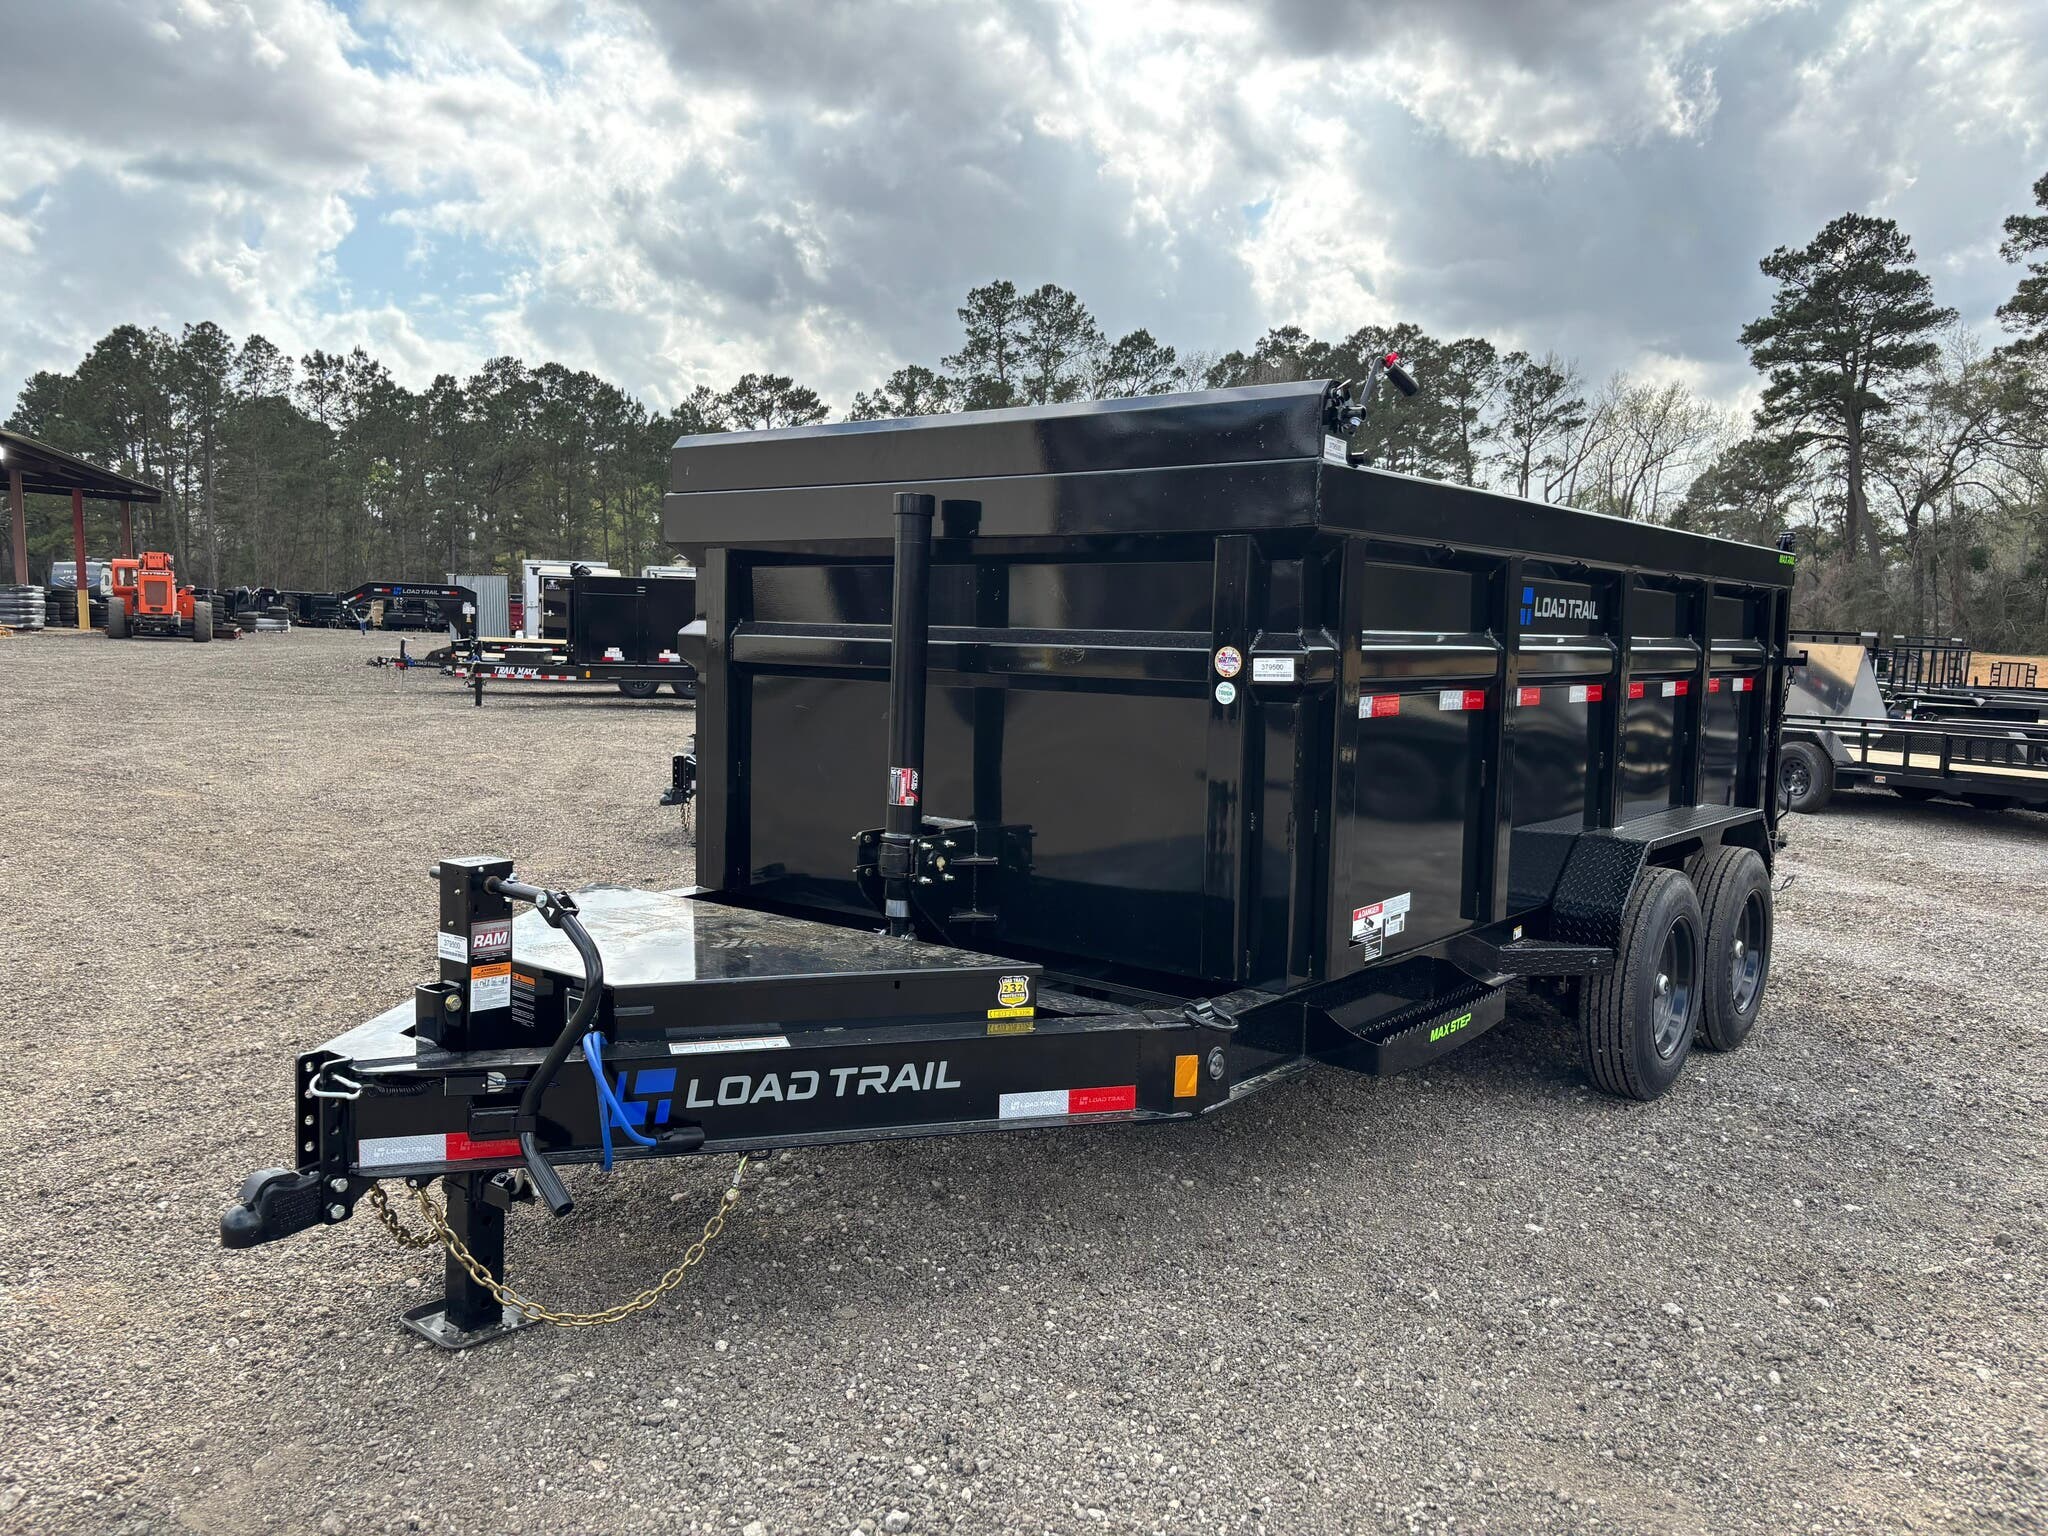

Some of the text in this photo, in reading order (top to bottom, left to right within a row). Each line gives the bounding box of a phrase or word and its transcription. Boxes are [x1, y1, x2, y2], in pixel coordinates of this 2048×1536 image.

[1534, 596, 1599, 620] LOAD TRAIL
[493, 666, 540, 676] TRAIL MAXX
[472, 930, 509, 949] RAM
[1003, 983, 1023, 993] 232
[1430, 1012, 1472, 1043] MAX STEP
[685, 1060, 961, 1109] LOAD TRAIL
[386, 1145, 434, 1155] LOAD TRAIL
